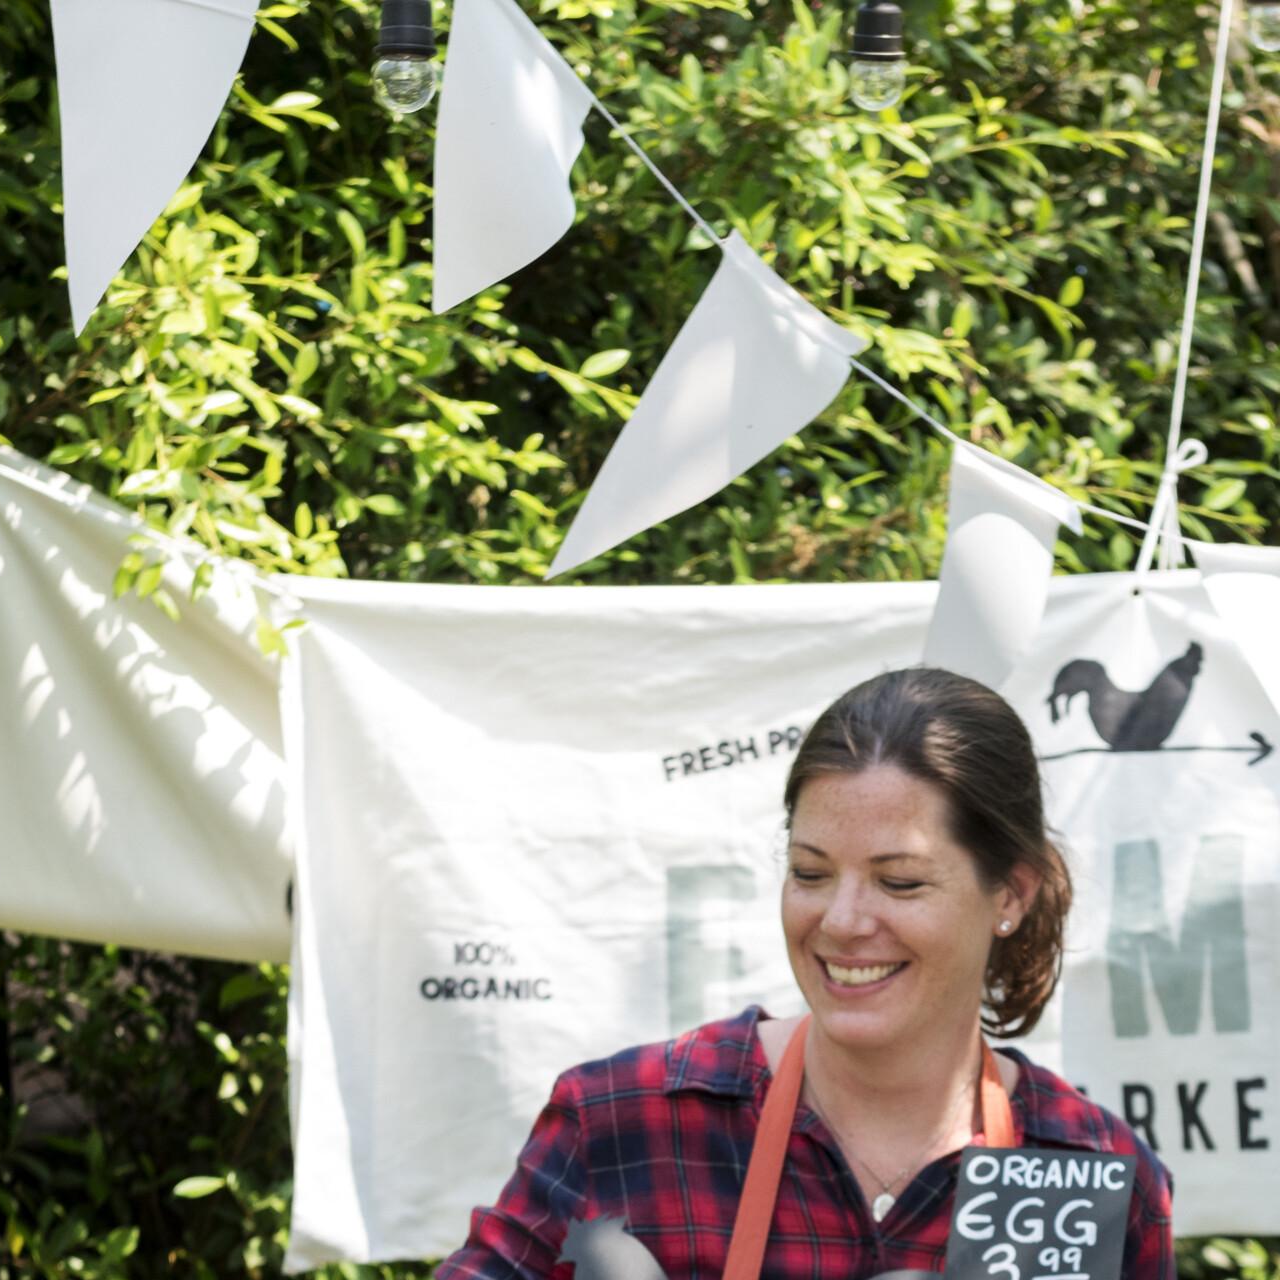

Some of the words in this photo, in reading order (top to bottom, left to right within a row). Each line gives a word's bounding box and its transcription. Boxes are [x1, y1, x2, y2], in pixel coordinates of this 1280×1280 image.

[662, 737, 759, 782] FRESH
[454, 941, 517, 966] 100%
[420, 976, 553, 1001] ORGANIC
[1074, 1077, 1270, 1152] RKE
[966, 1155, 1126, 1190] ORGANIC
[956, 1191, 1098, 1246] EGG
[1038, 1246, 1083, 1273] 99
